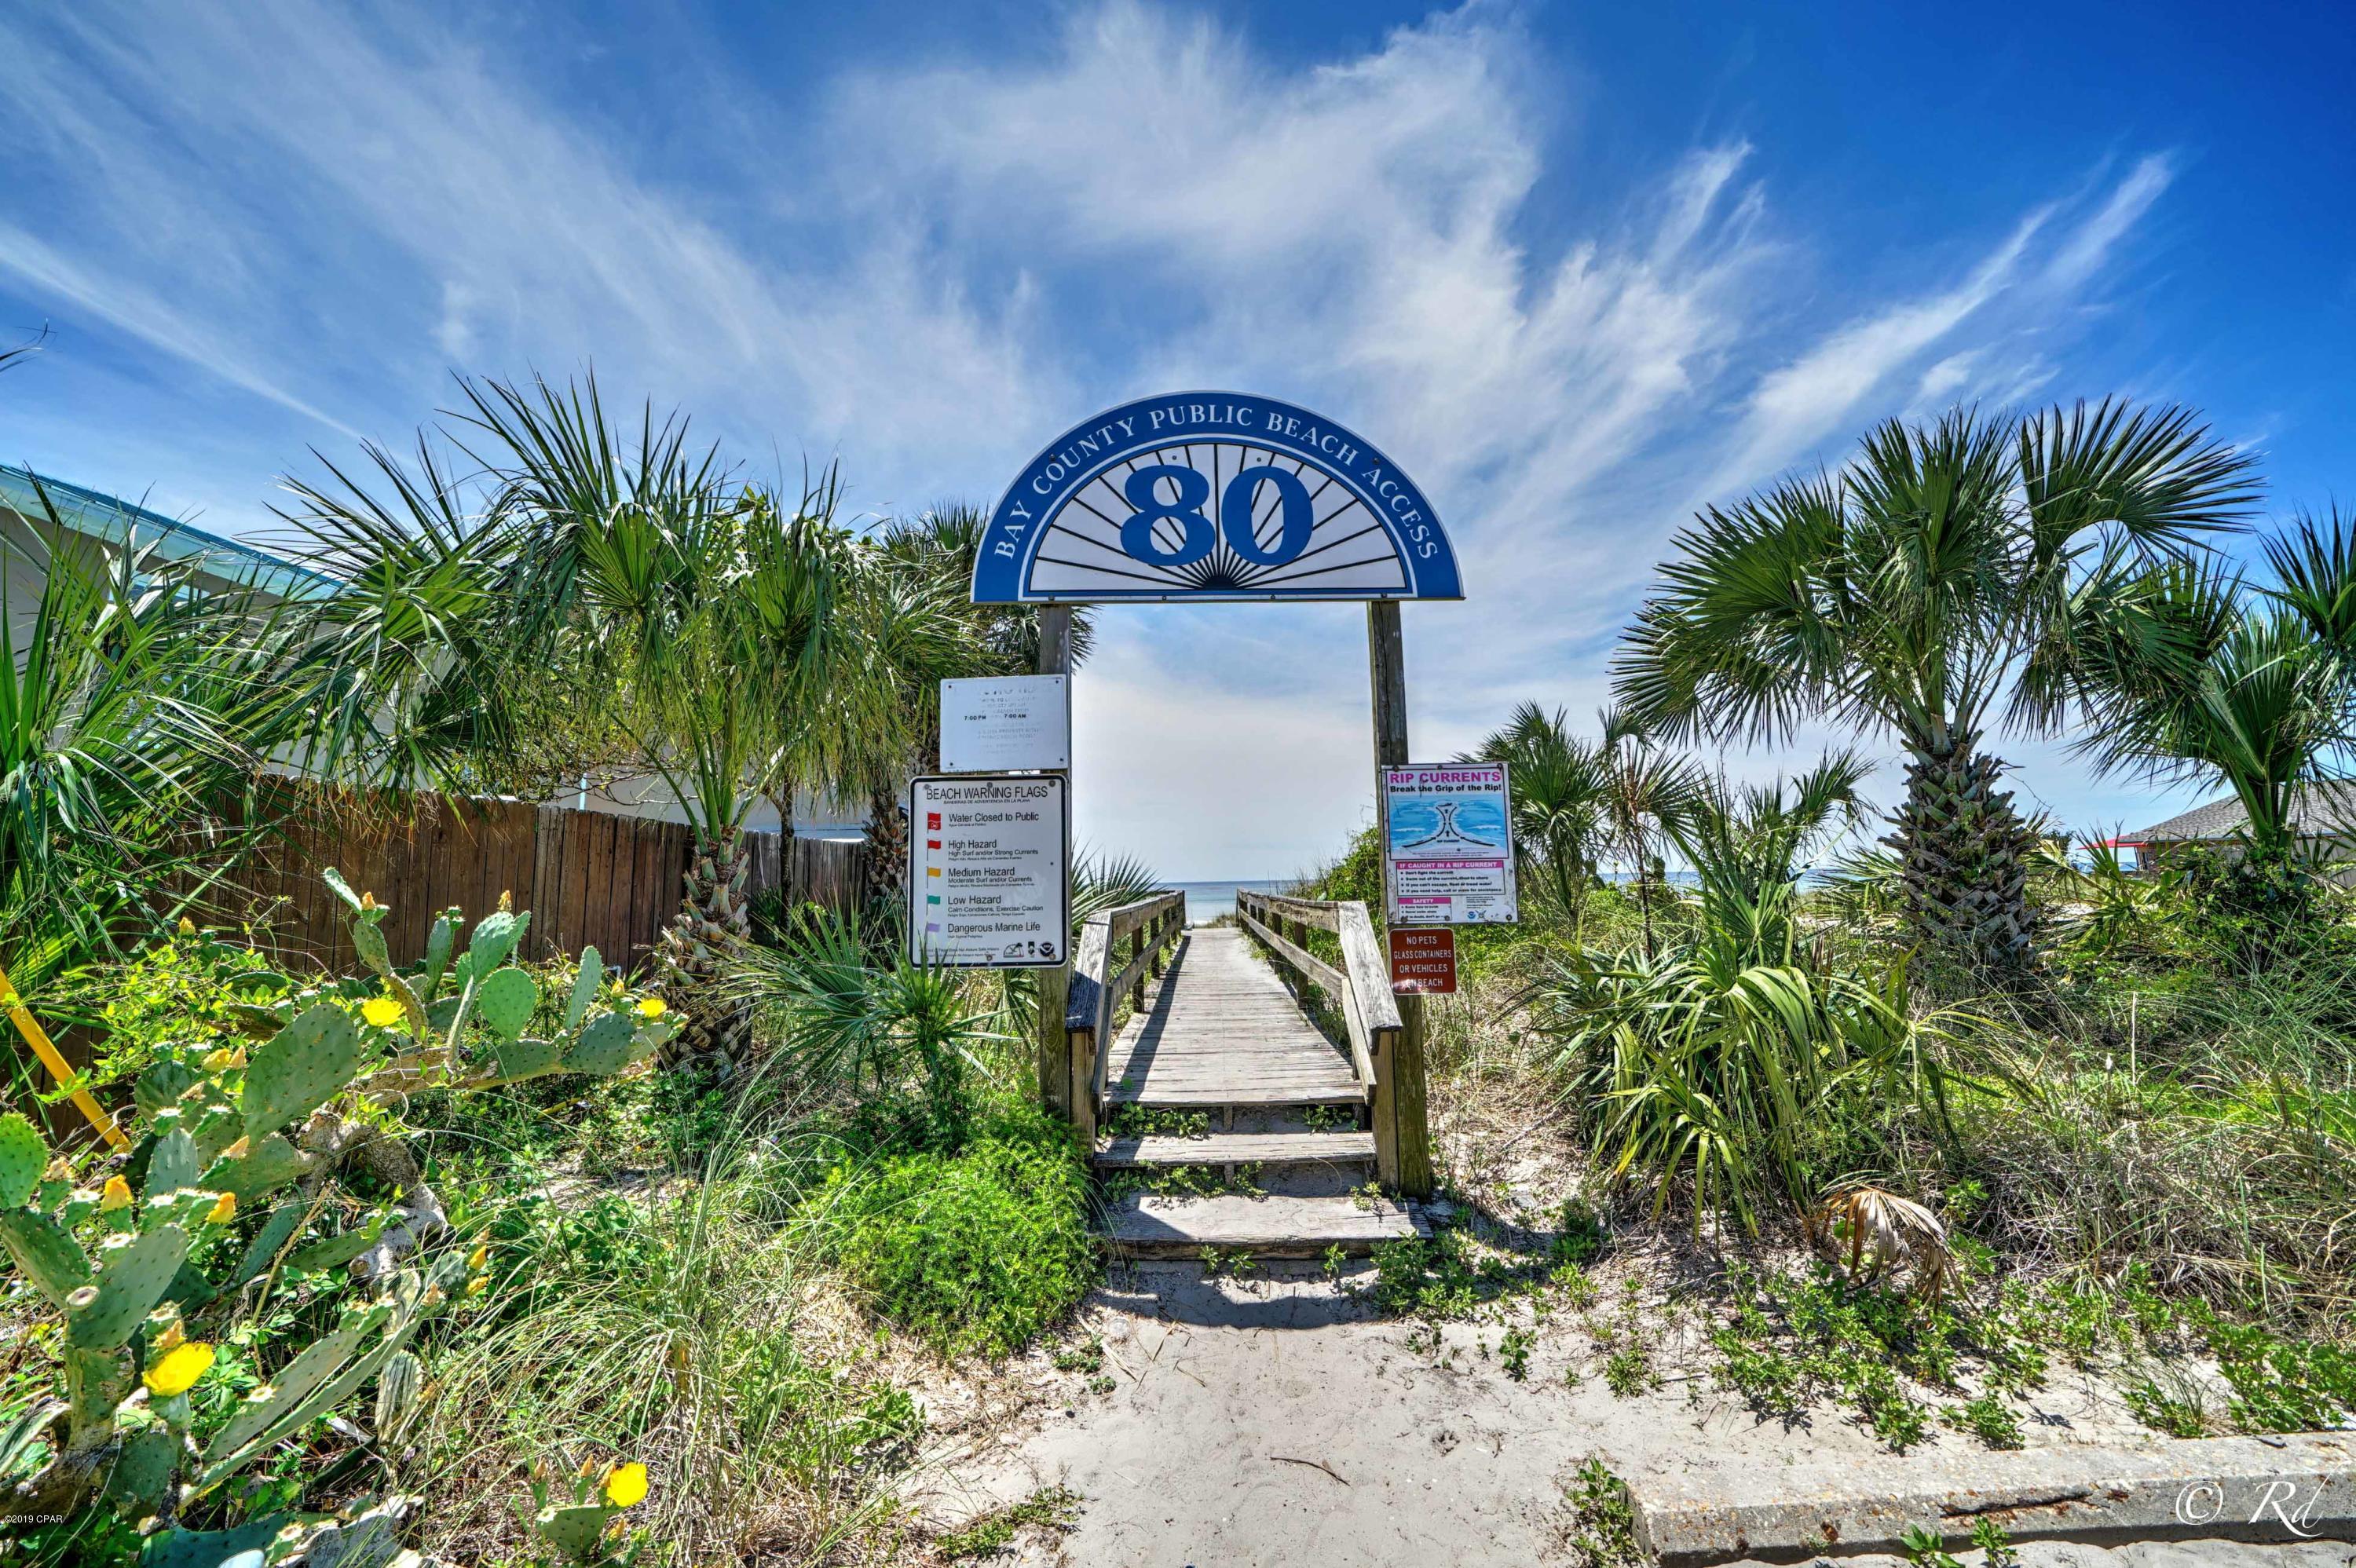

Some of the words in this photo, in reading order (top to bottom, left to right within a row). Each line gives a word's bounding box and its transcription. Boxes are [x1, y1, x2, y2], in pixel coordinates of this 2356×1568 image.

[994, 500, 1036, 560] BAY
[1031, 417, 1137, 495] COUNTY
[1149, 404, 1253, 430] PUBLIC
[1265, 412, 1361, 466] BEACH
[1361, 466, 1440, 560] ACCESS
[1120, 464, 1315, 566] 80
[1389, 773, 1414, 784] RIP
[1419, 771, 1501, 783] CURRENTS
[926, 788, 961, 800] BEACH
[964, 786, 1012, 799] WARNING
[1015, 786, 1048, 798] FLAGS
[949, 813, 972, 822] Water
[975, 813, 1002, 822] Closed
[1015, 812, 1039, 821] Public
[948, 840, 966, 851] High
[968, 839, 997, 849] Hazard
[948, 868, 981, 877] Medium
[984, 867, 1015, 876] Hazard
[948, 896, 966, 905] Low
[969, 895, 1001, 904] Hazard
[948, 923, 993, 934] Dangerous
[995, 923, 1023, 932] Marine
[1026, 922, 1041, 931] Life
[1407, 936, 1417, 945] NO
[1419, 936, 1437, 944] PETS
[1394, 950, 1413, 959] GLASS
[1414, 950, 1452, 959] CONTAINERS
[1399, 964, 1410, 973] OR
[1411, 964, 1448, 973] VEHICLES
[1418, 978, 1443, 987] BEACH
